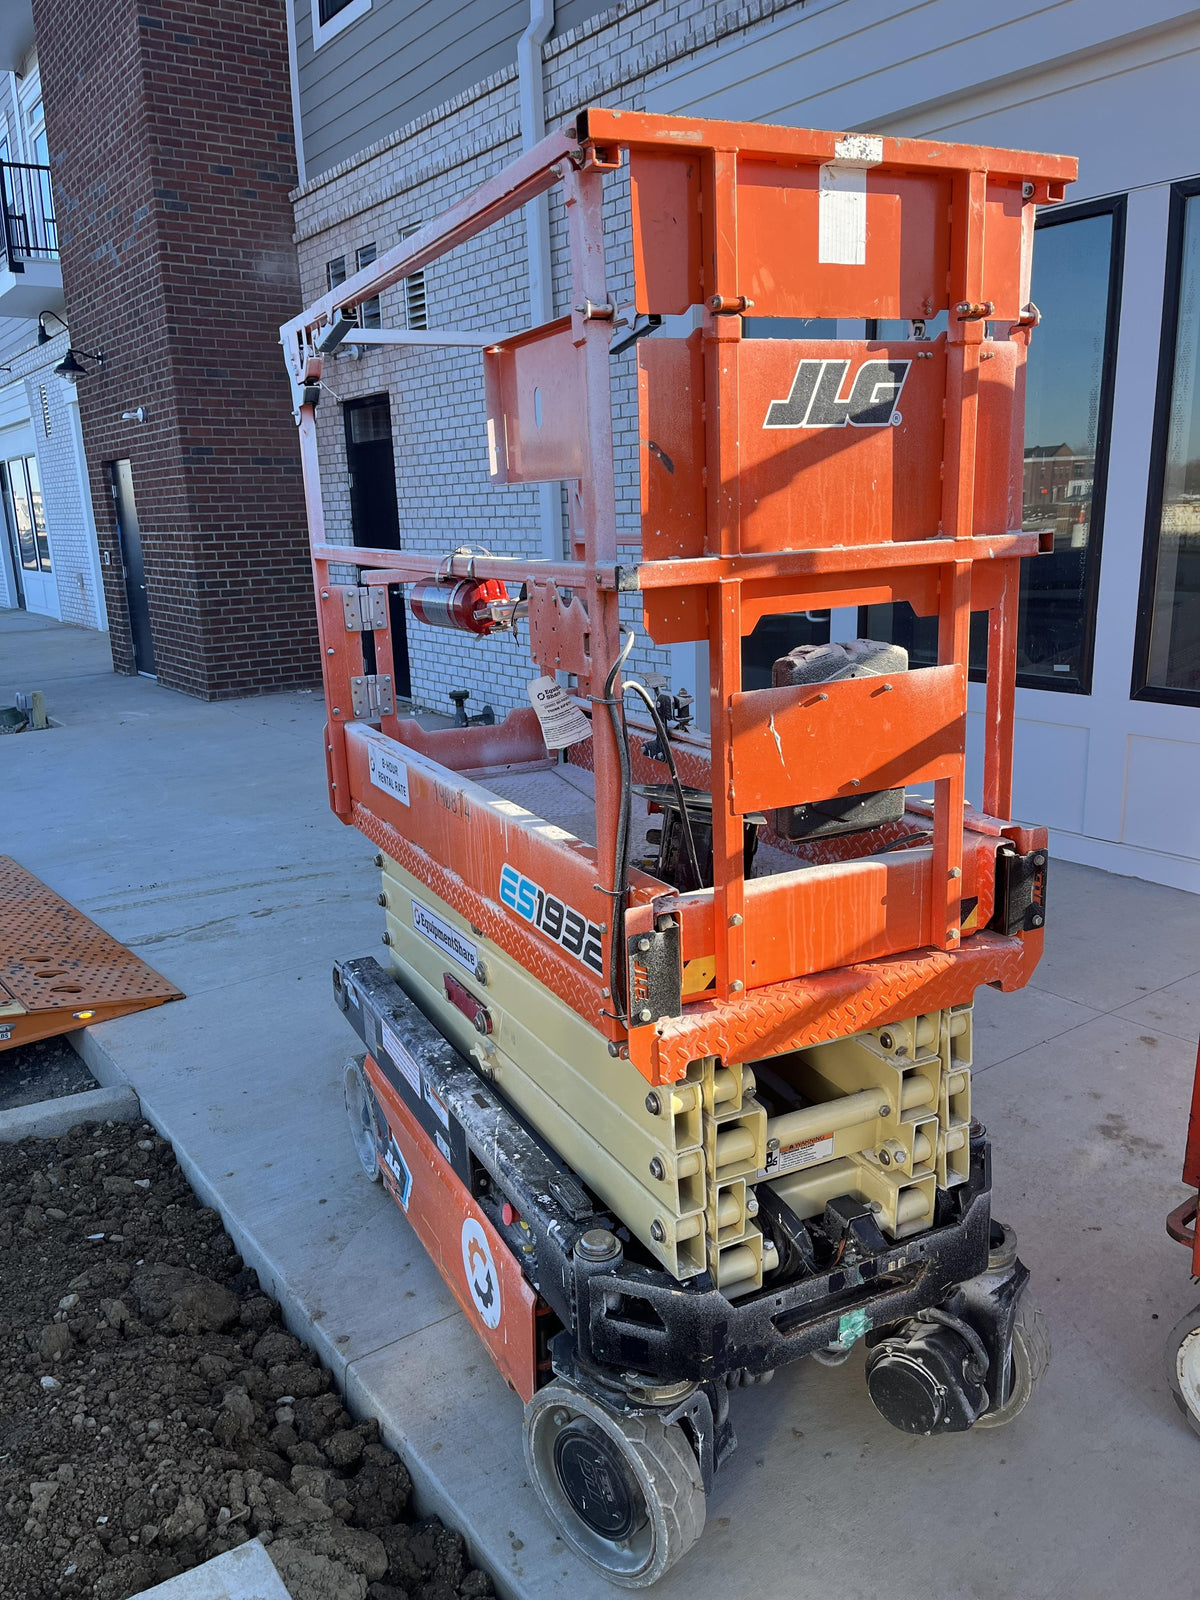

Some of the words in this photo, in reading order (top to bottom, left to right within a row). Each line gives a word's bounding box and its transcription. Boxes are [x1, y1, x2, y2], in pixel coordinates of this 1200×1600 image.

[763, 359, 912, 429] JLG
[378, 771, 394, 790] RENTAL
[394, 779, 407, 797] RATE
[420, 912, 475, 966] EquipmentShare
